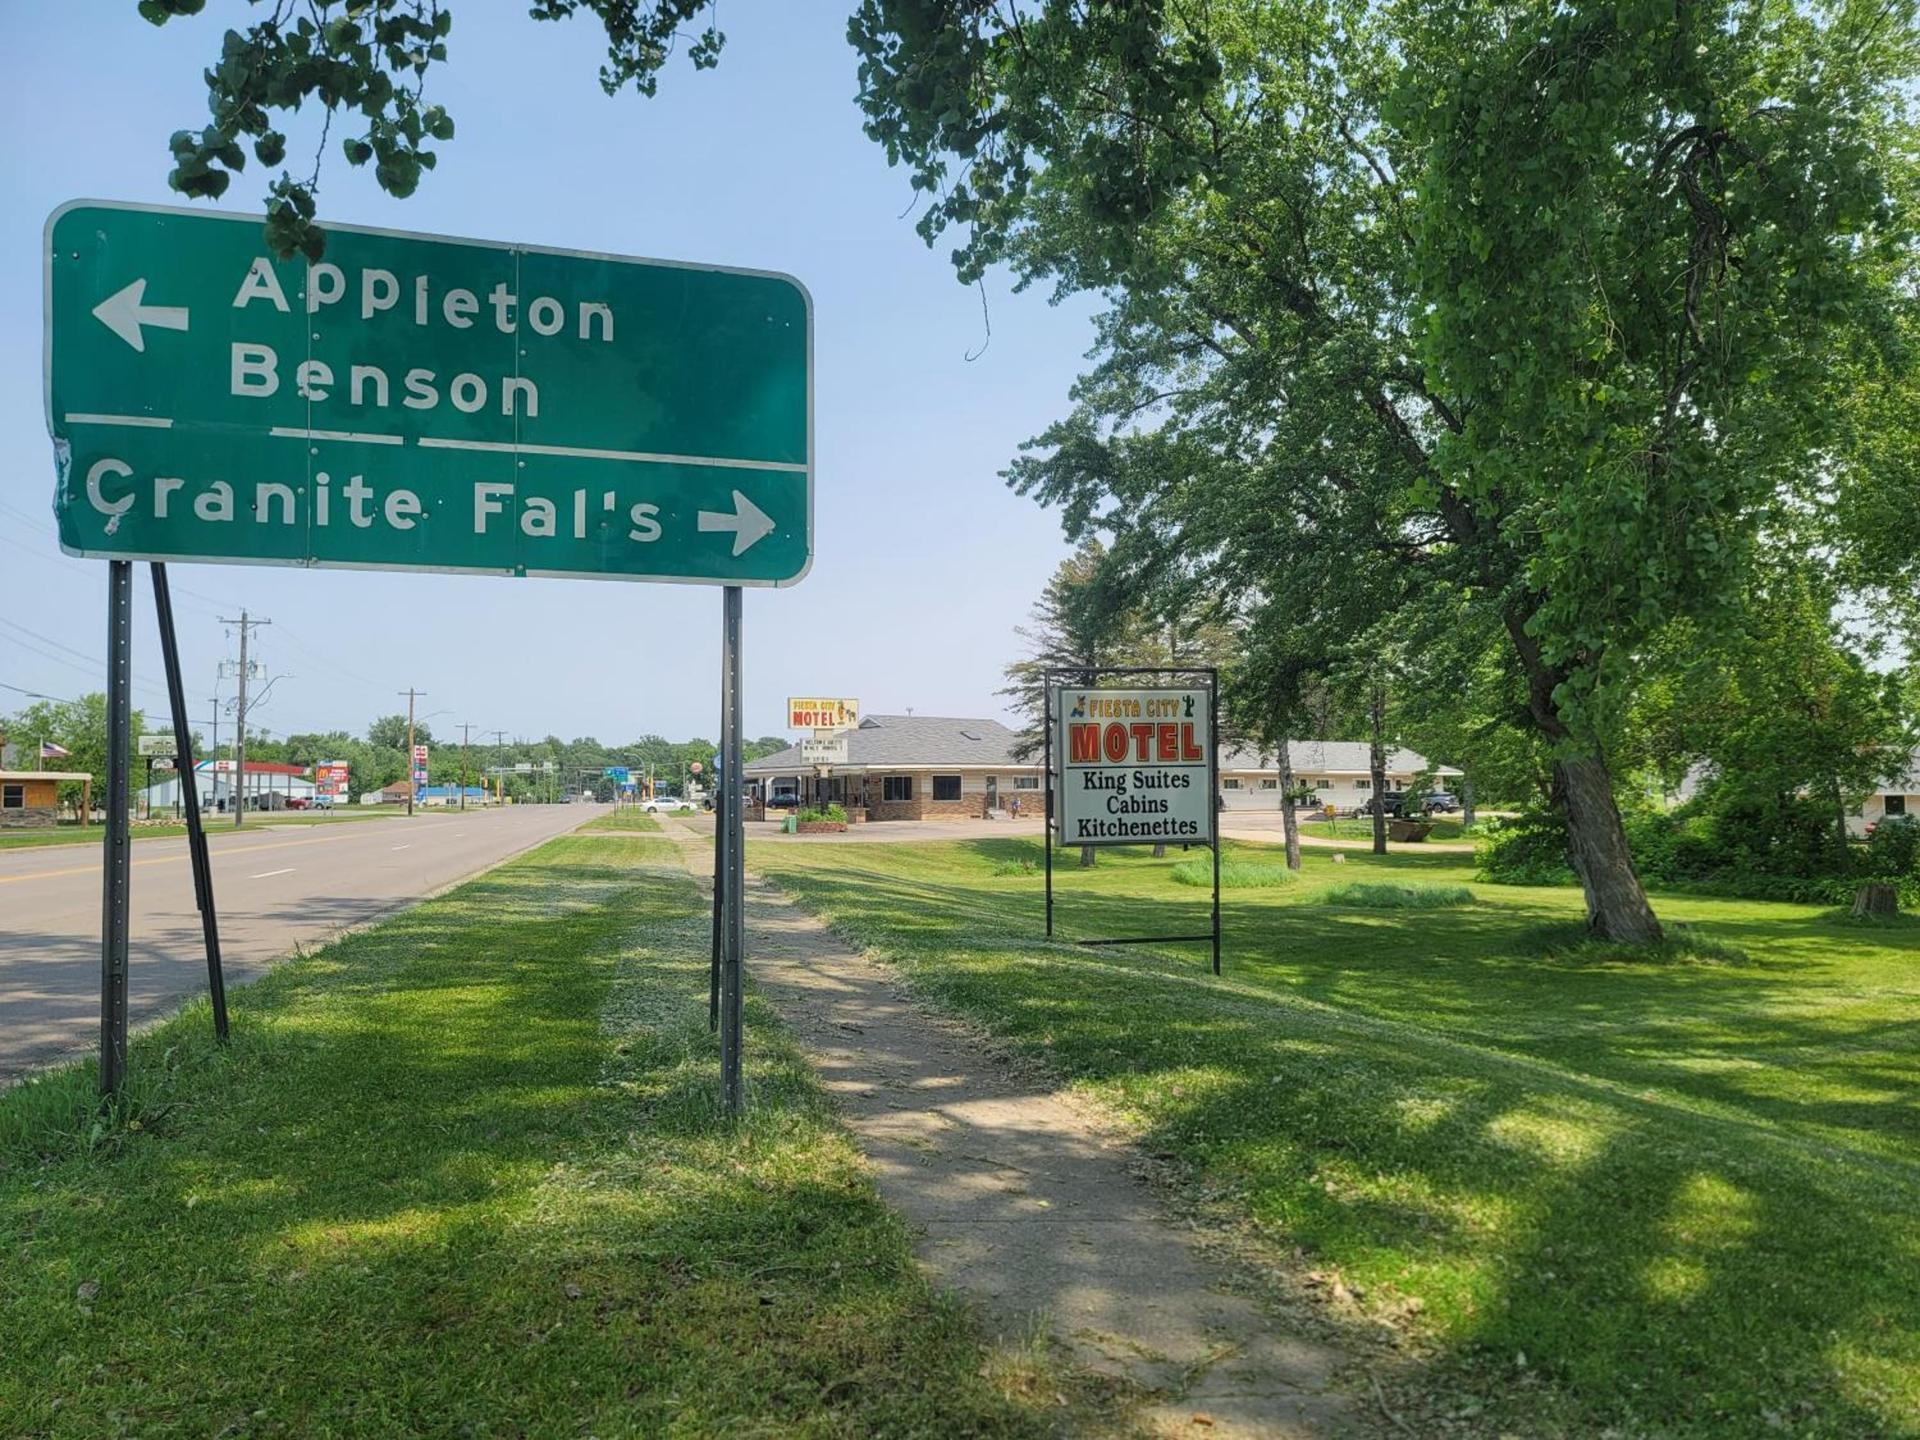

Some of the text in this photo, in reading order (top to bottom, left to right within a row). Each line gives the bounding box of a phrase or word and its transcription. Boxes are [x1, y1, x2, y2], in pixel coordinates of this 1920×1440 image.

[232, 256, 614, 342] Appleton
[231, 342, 539, 417] Benson
[793, 711, 835, 726] MOTEL
[1090, 698, 1180, 717] FIESTA CITY
[1069, 722, 1203, 763] MOTEL
[1083, 770, 1190, 795] King Suites
[1107, 795, 1168, 814] Cabins
[1077, 817, 1198, 837] Kitchenettes
